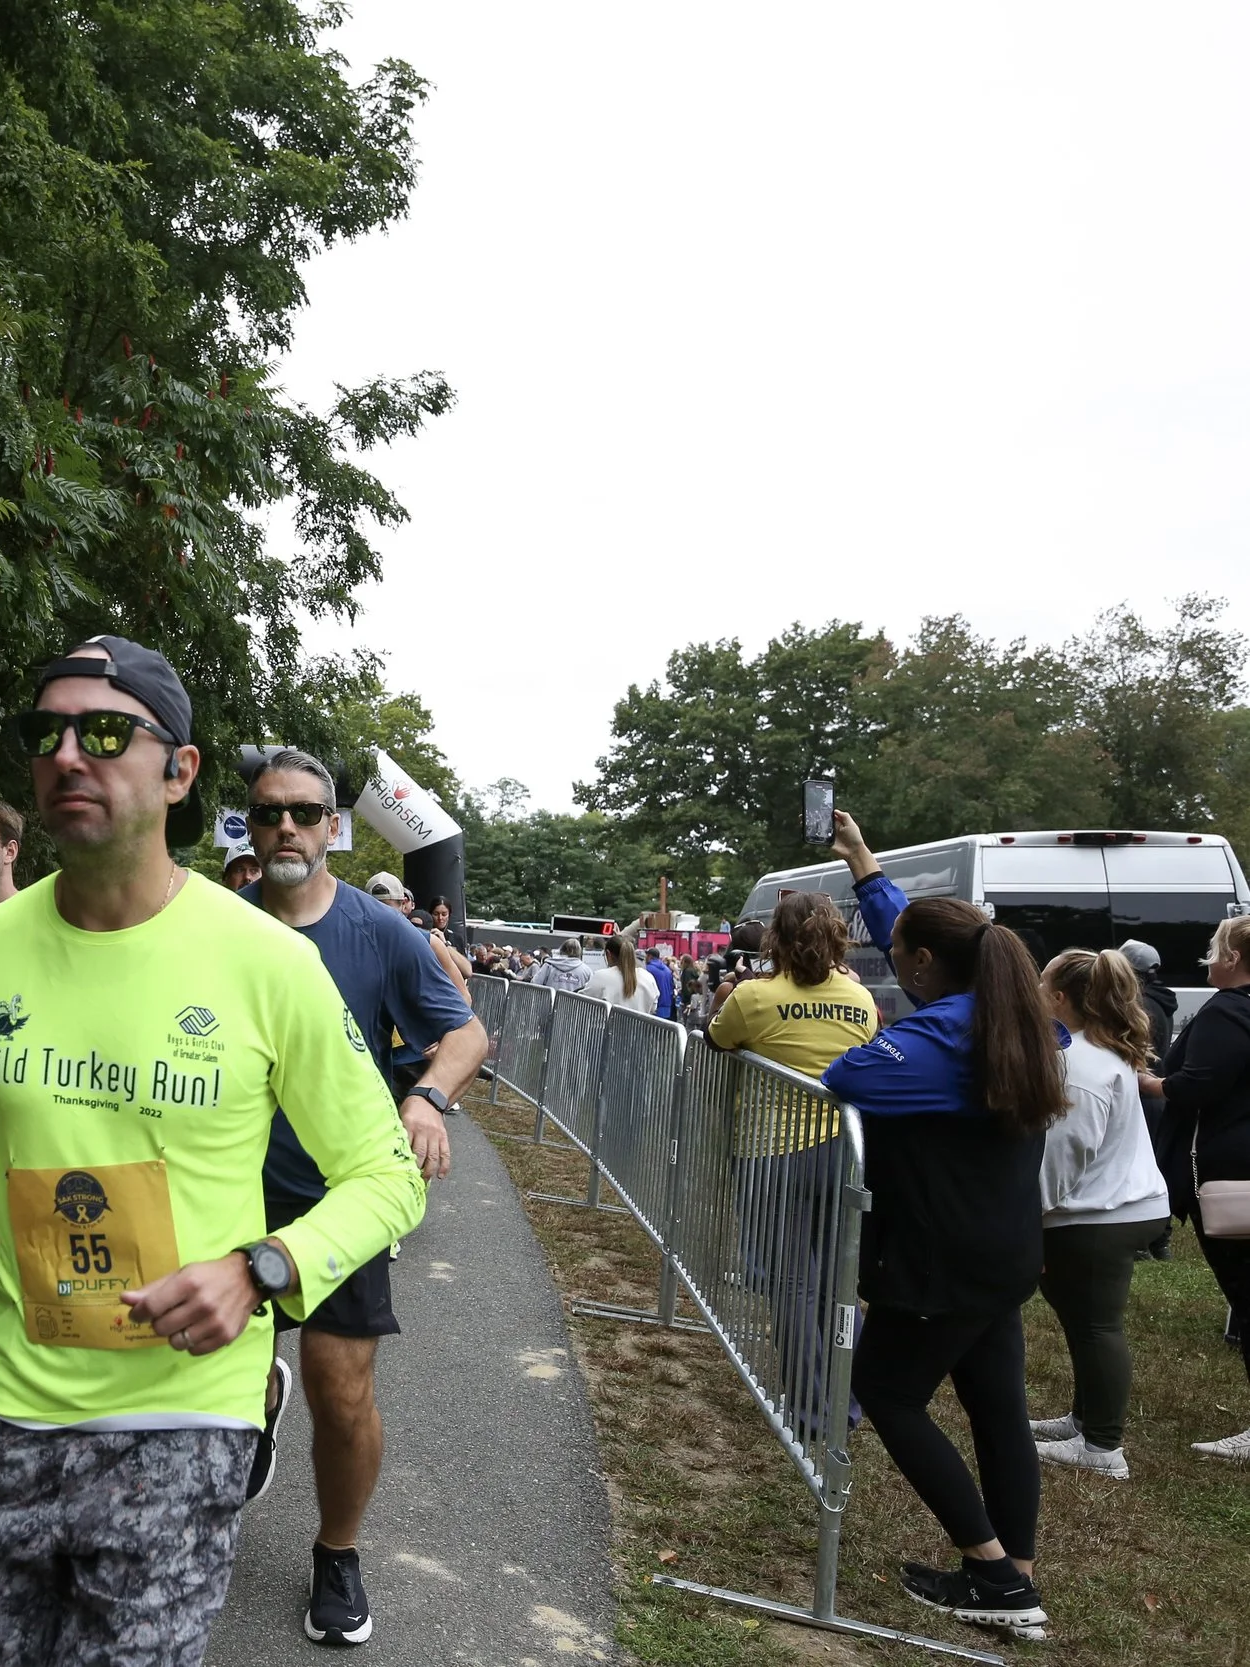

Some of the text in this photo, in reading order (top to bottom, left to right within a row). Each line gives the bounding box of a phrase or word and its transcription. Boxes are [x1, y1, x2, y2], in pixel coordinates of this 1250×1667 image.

[776, 1002, 869, 1027] VOLUNTEER
[877, 1038, 905, 1062] VARGAS
[43, 1048, 137, 1102] Turkey
[152, 1060, 220, 1108] Run!
[53, 1094, 163, 1119] Thanksgiving 2022
[72, 1193, 105, 1204] STRONG
[69, 1233, 113, 1275] 55
[72, 1277, 131, 1292] DUFFY
